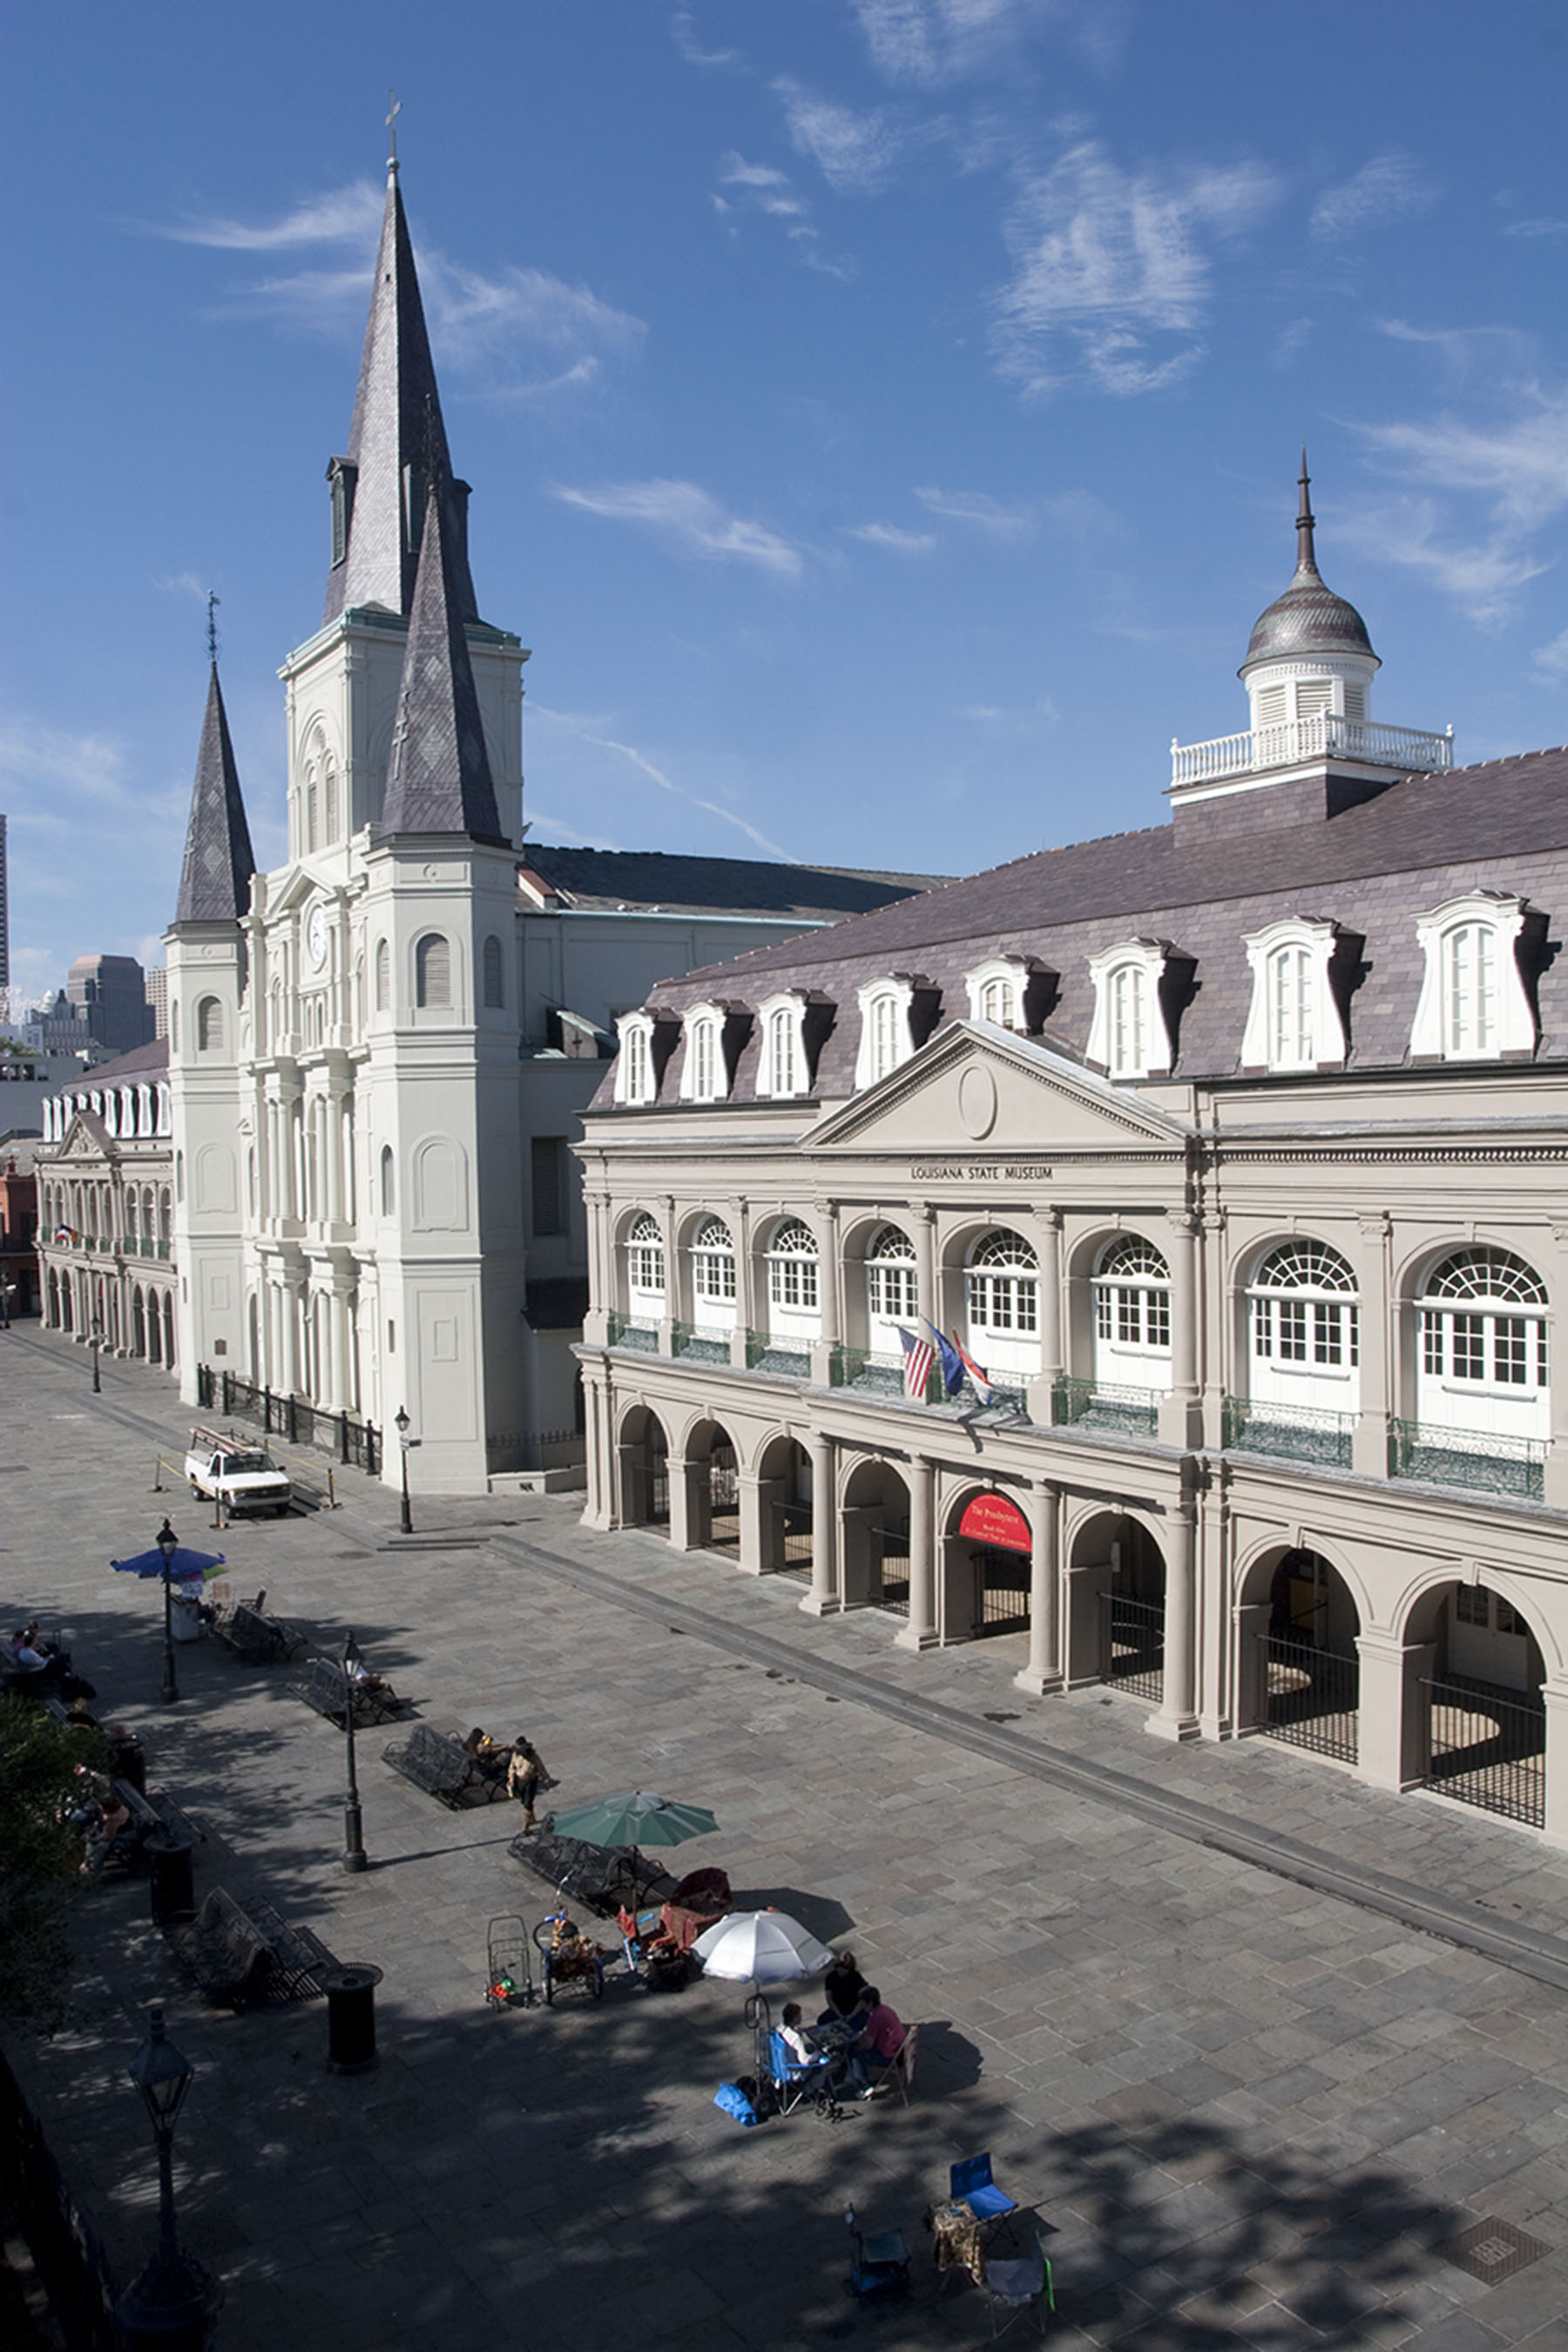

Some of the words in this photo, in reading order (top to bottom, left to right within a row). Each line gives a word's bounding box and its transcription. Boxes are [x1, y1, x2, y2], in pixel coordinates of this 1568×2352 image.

[911, 1166, 964, 1179] LOUISIANA
[968, 1166, 999, 1179] STATE
[1004, 1166, 1053, 1179] MUSEUM
